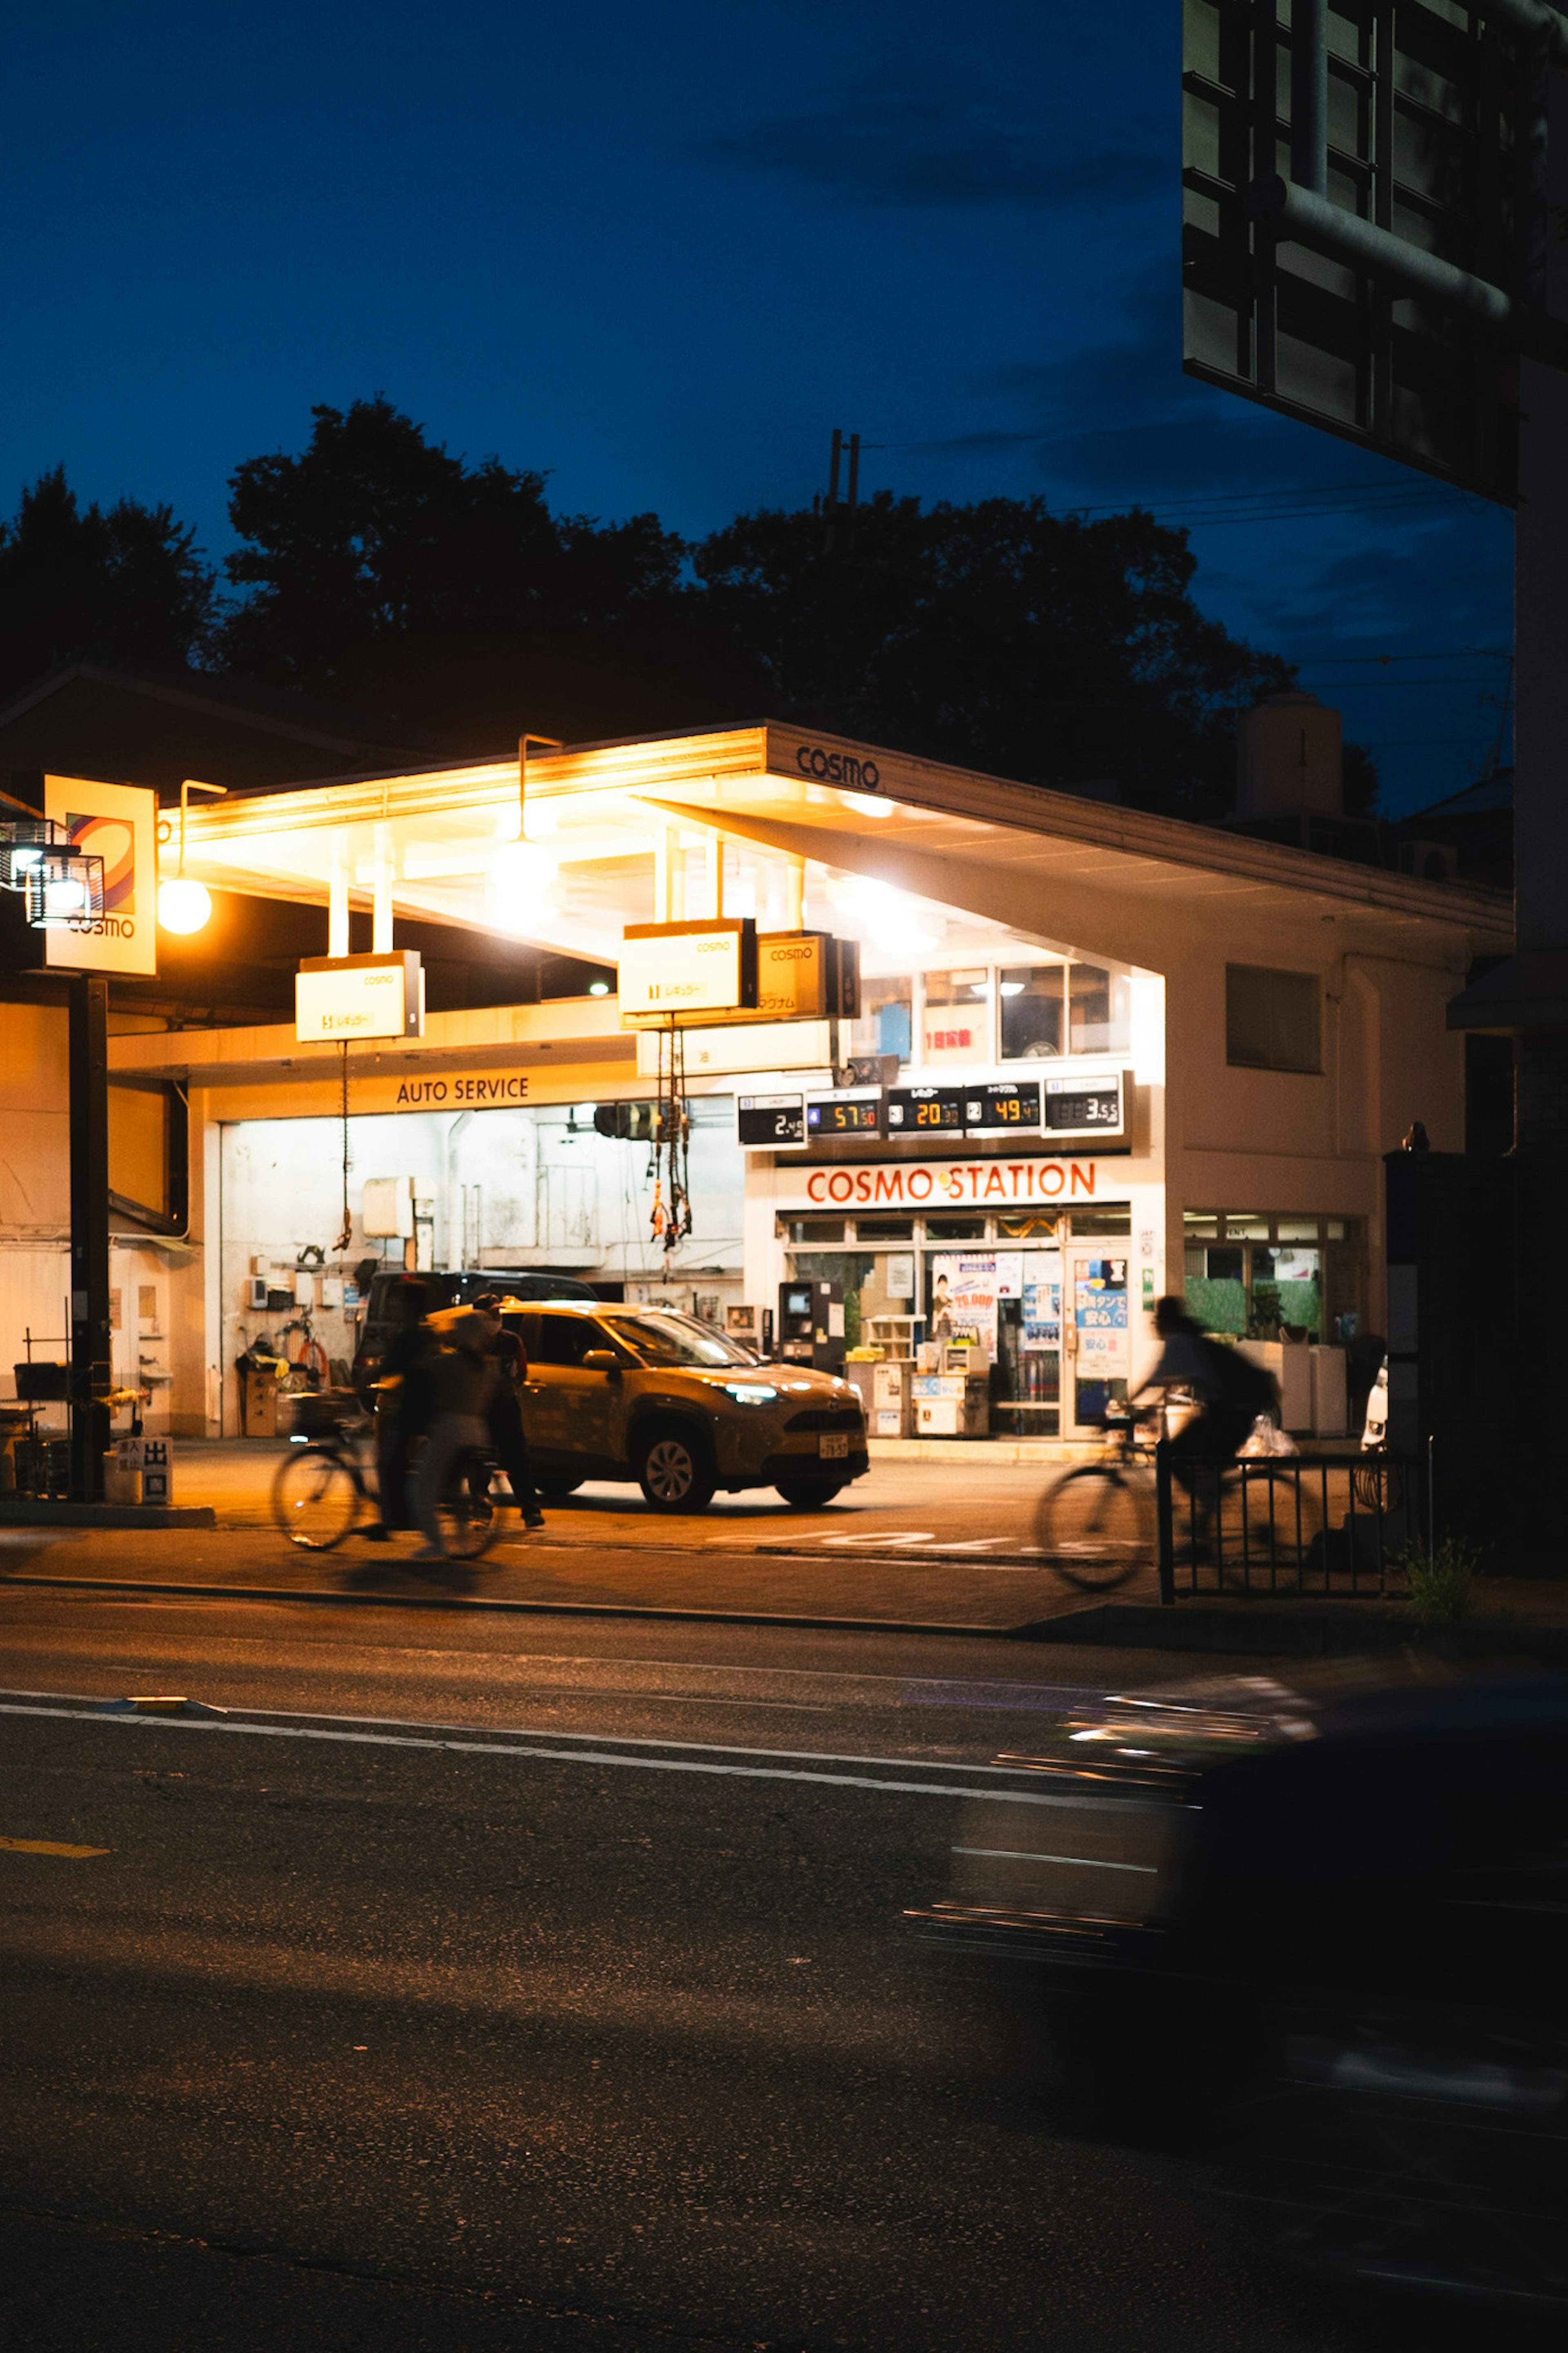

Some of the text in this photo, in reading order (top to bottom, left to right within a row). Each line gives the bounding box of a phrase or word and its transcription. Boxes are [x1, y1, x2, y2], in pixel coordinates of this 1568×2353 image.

[797, 746, 879, 788] COSMO
[697, 942, 730, 952] COSMO
[771, 948, 812, 961] COSMO
[364, 975, 393, 985] COSMO
[666, 984, 700, 996] レギュラー
[396, 1077, 528, 1103] AUTO SERVICE
[807, 1163, 1095, 1202] COSMO STATION
[145, 1442, 167, 1497] 出口
